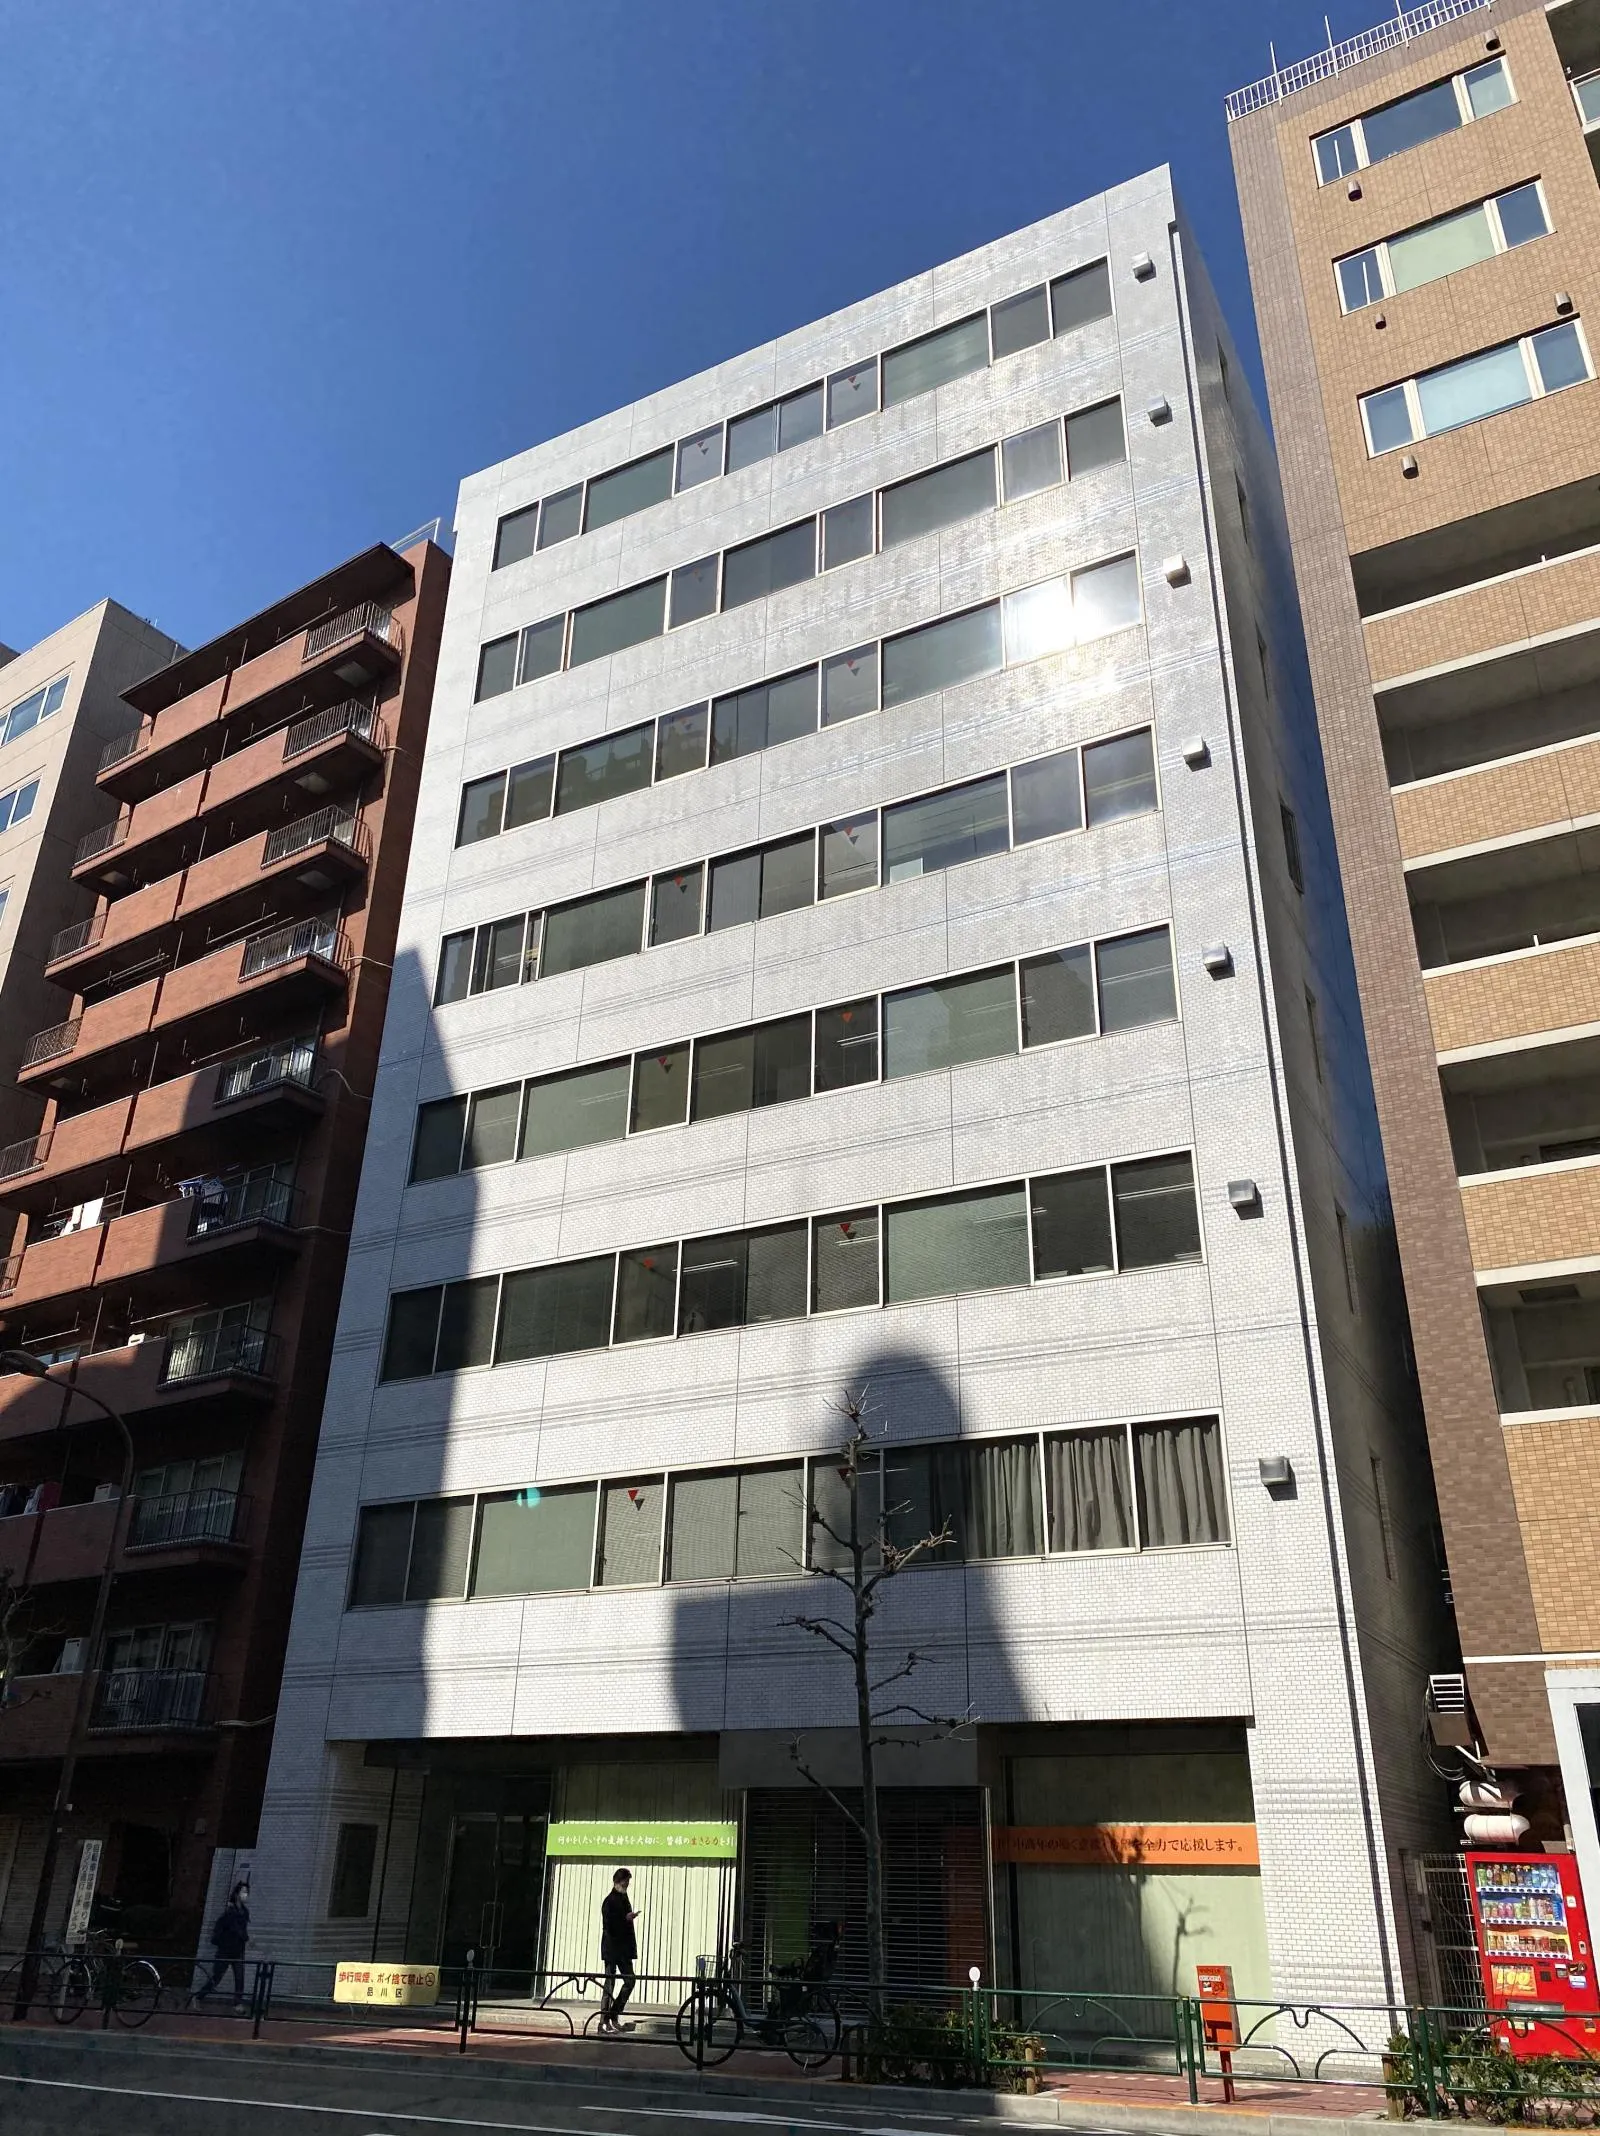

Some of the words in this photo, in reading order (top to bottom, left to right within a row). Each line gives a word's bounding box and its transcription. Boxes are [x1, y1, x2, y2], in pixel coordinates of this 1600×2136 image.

[339, 1972, 424, 1985] 歩行喫煙、ポイ捨て禁止
